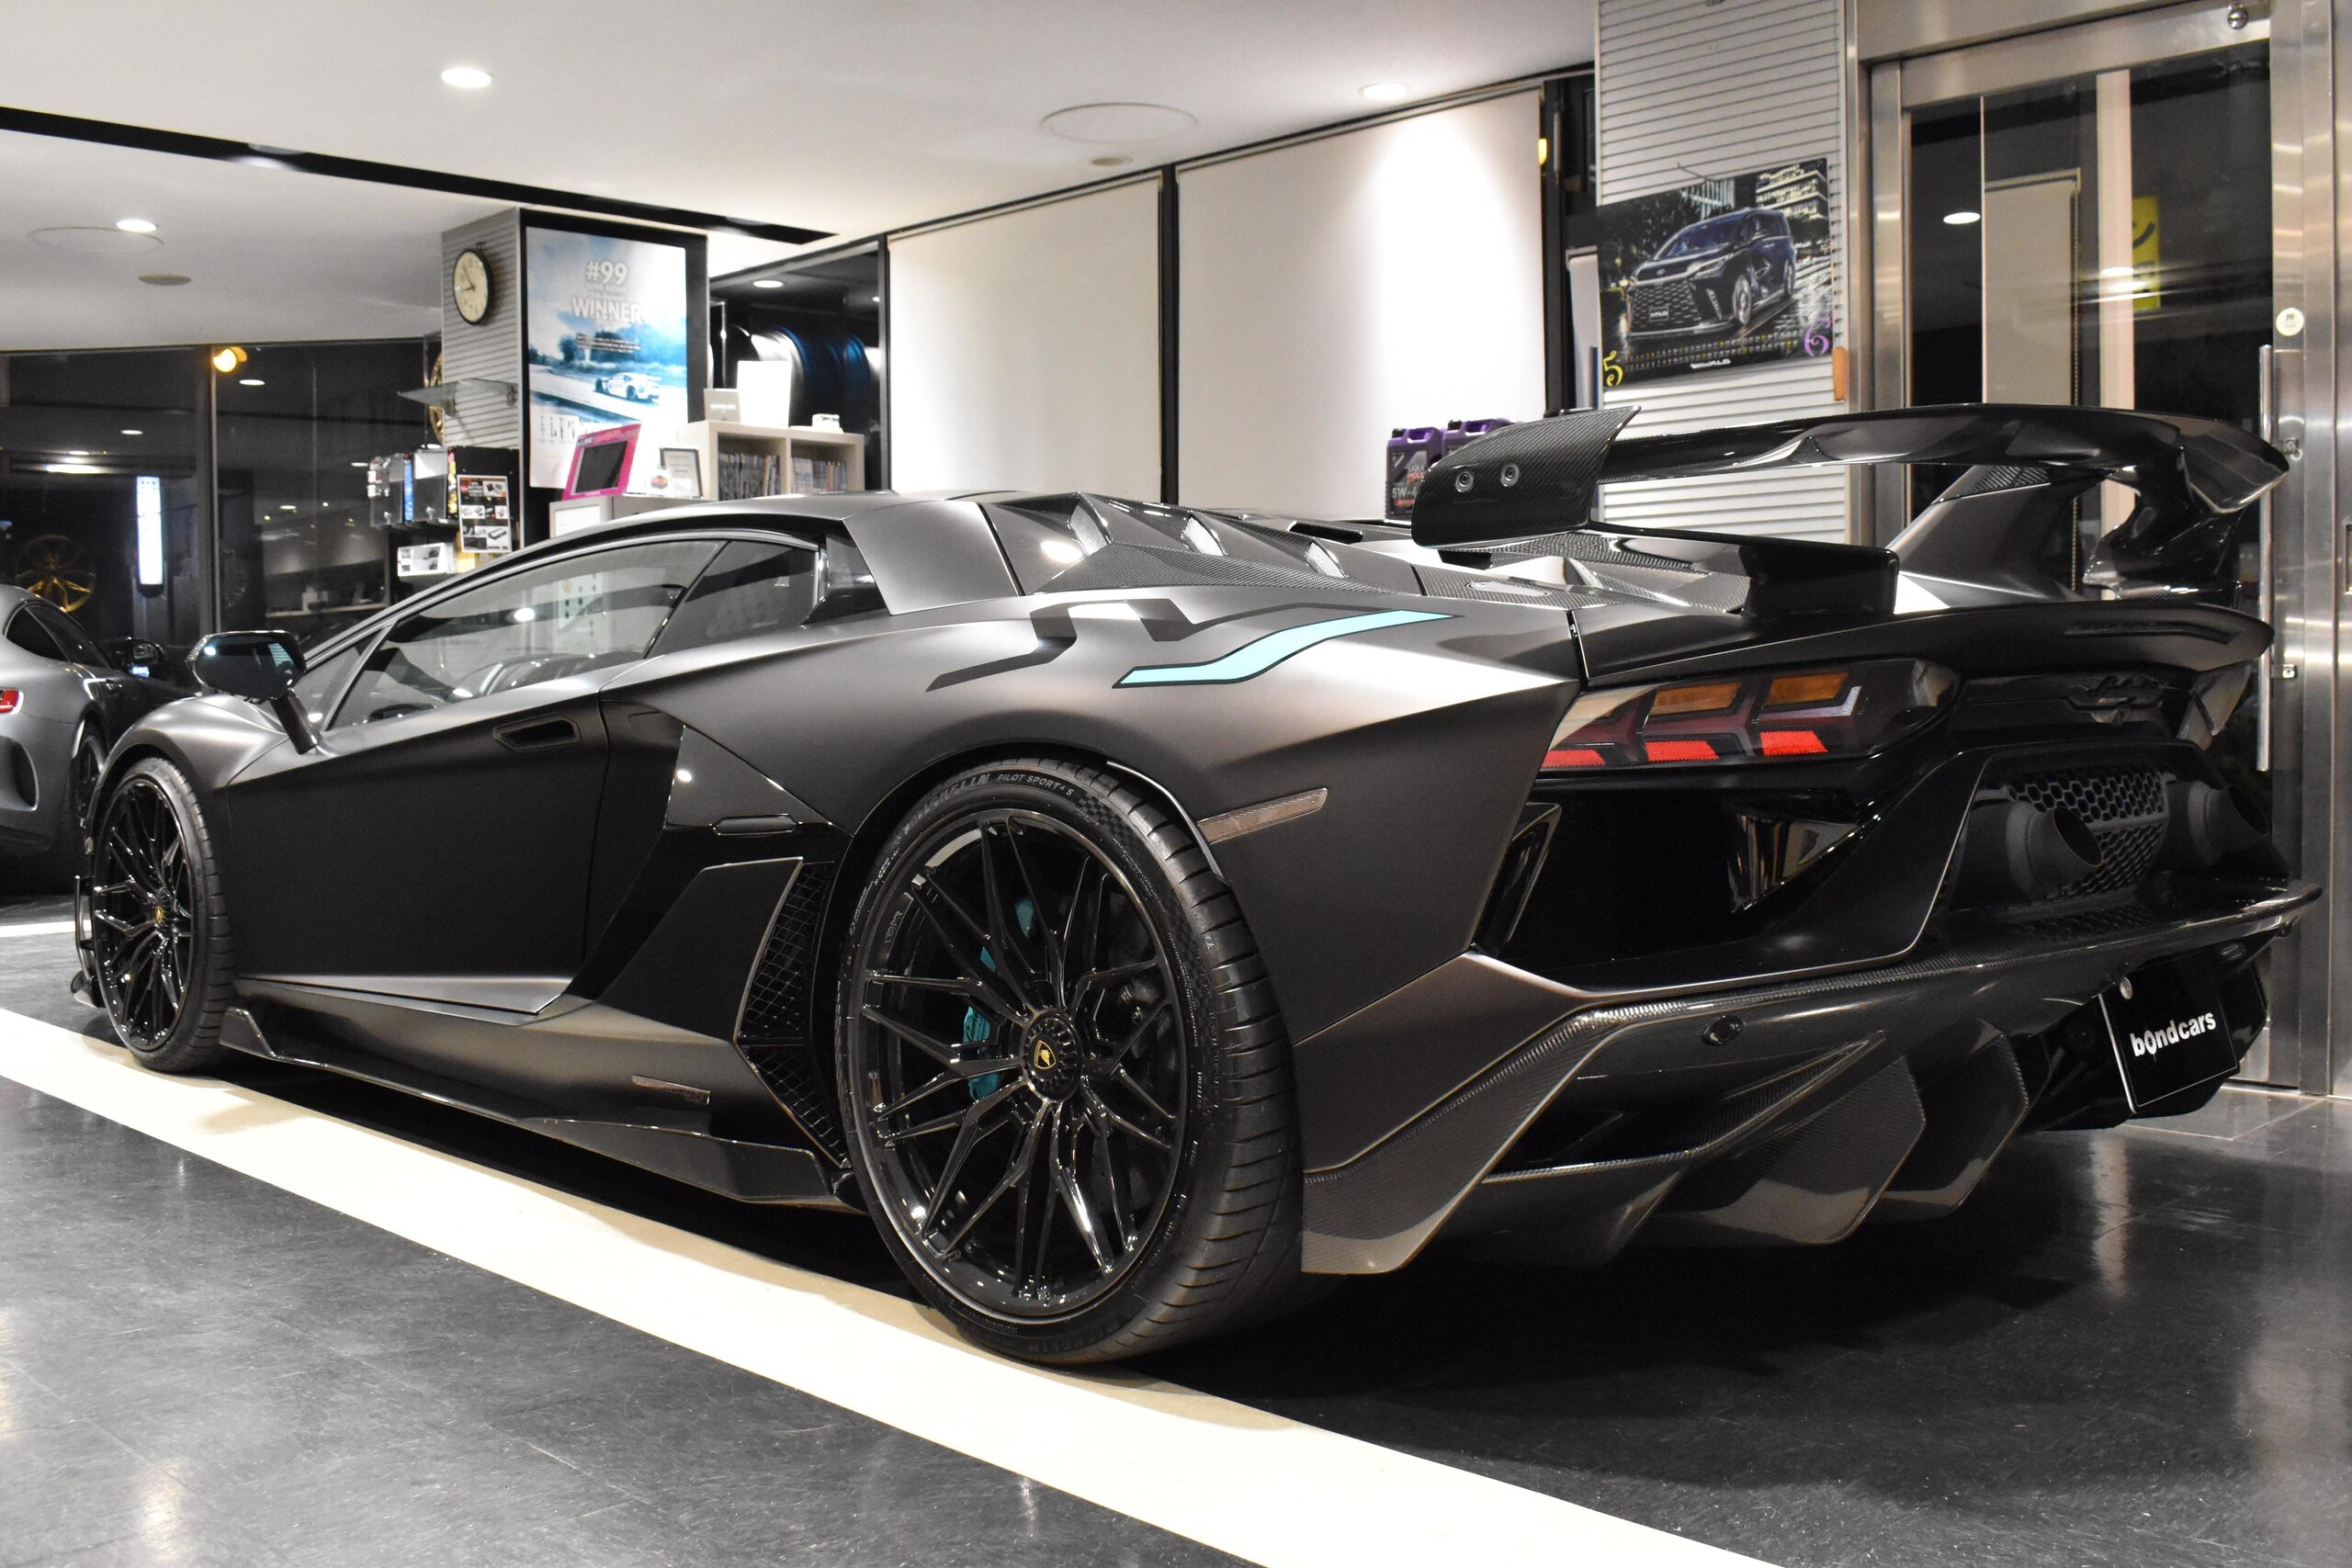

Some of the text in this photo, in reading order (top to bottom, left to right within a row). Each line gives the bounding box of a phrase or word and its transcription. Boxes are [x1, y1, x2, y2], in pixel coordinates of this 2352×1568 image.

[588, 261, 628, 285] #99
[571, 297, 643, 323] WINNER
[1804, 321, 1832, 356] 6
[1603, 350, 1623, 387] 5
[1392, 487, 1417, 499] 5W-4
[1026, 774, 1060, 790] SPORT
